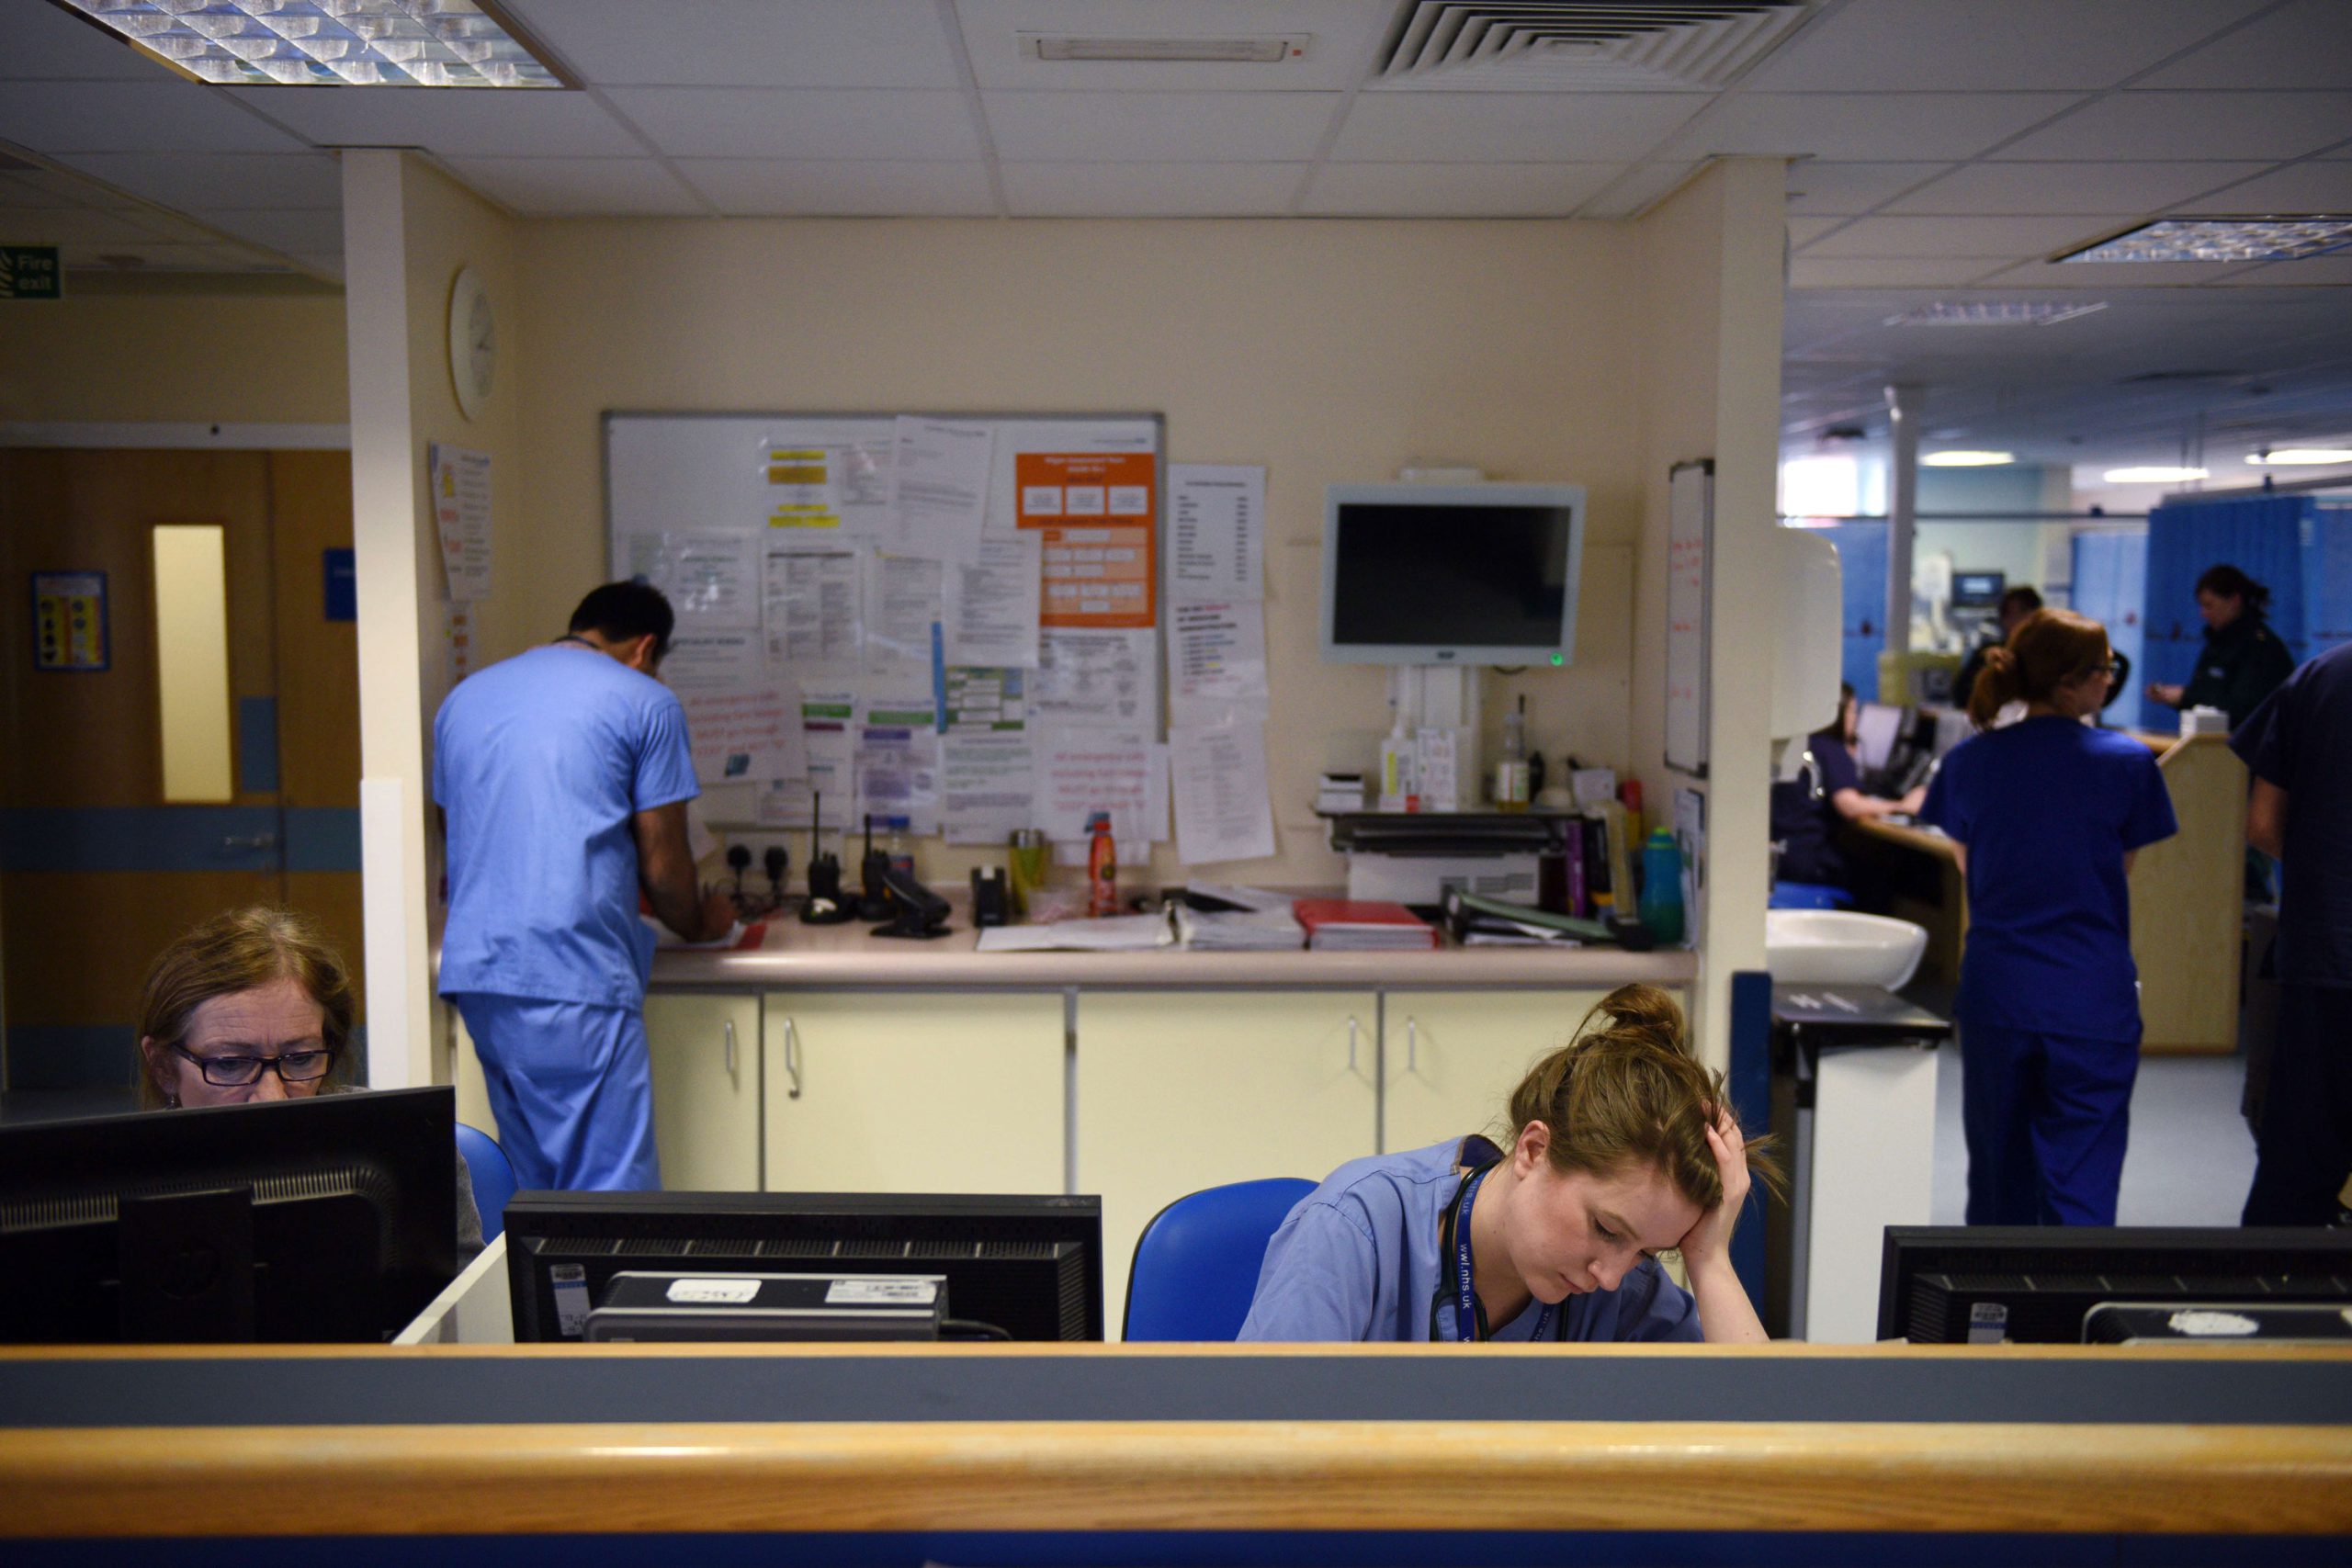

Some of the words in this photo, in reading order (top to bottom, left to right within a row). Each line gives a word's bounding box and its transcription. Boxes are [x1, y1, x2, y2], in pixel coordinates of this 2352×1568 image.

[17, 254, 52, 271] Fire
[18, 274, 51, 290] exit
[1460, 1244, 1472, 1309] wwl.nhs.uk
